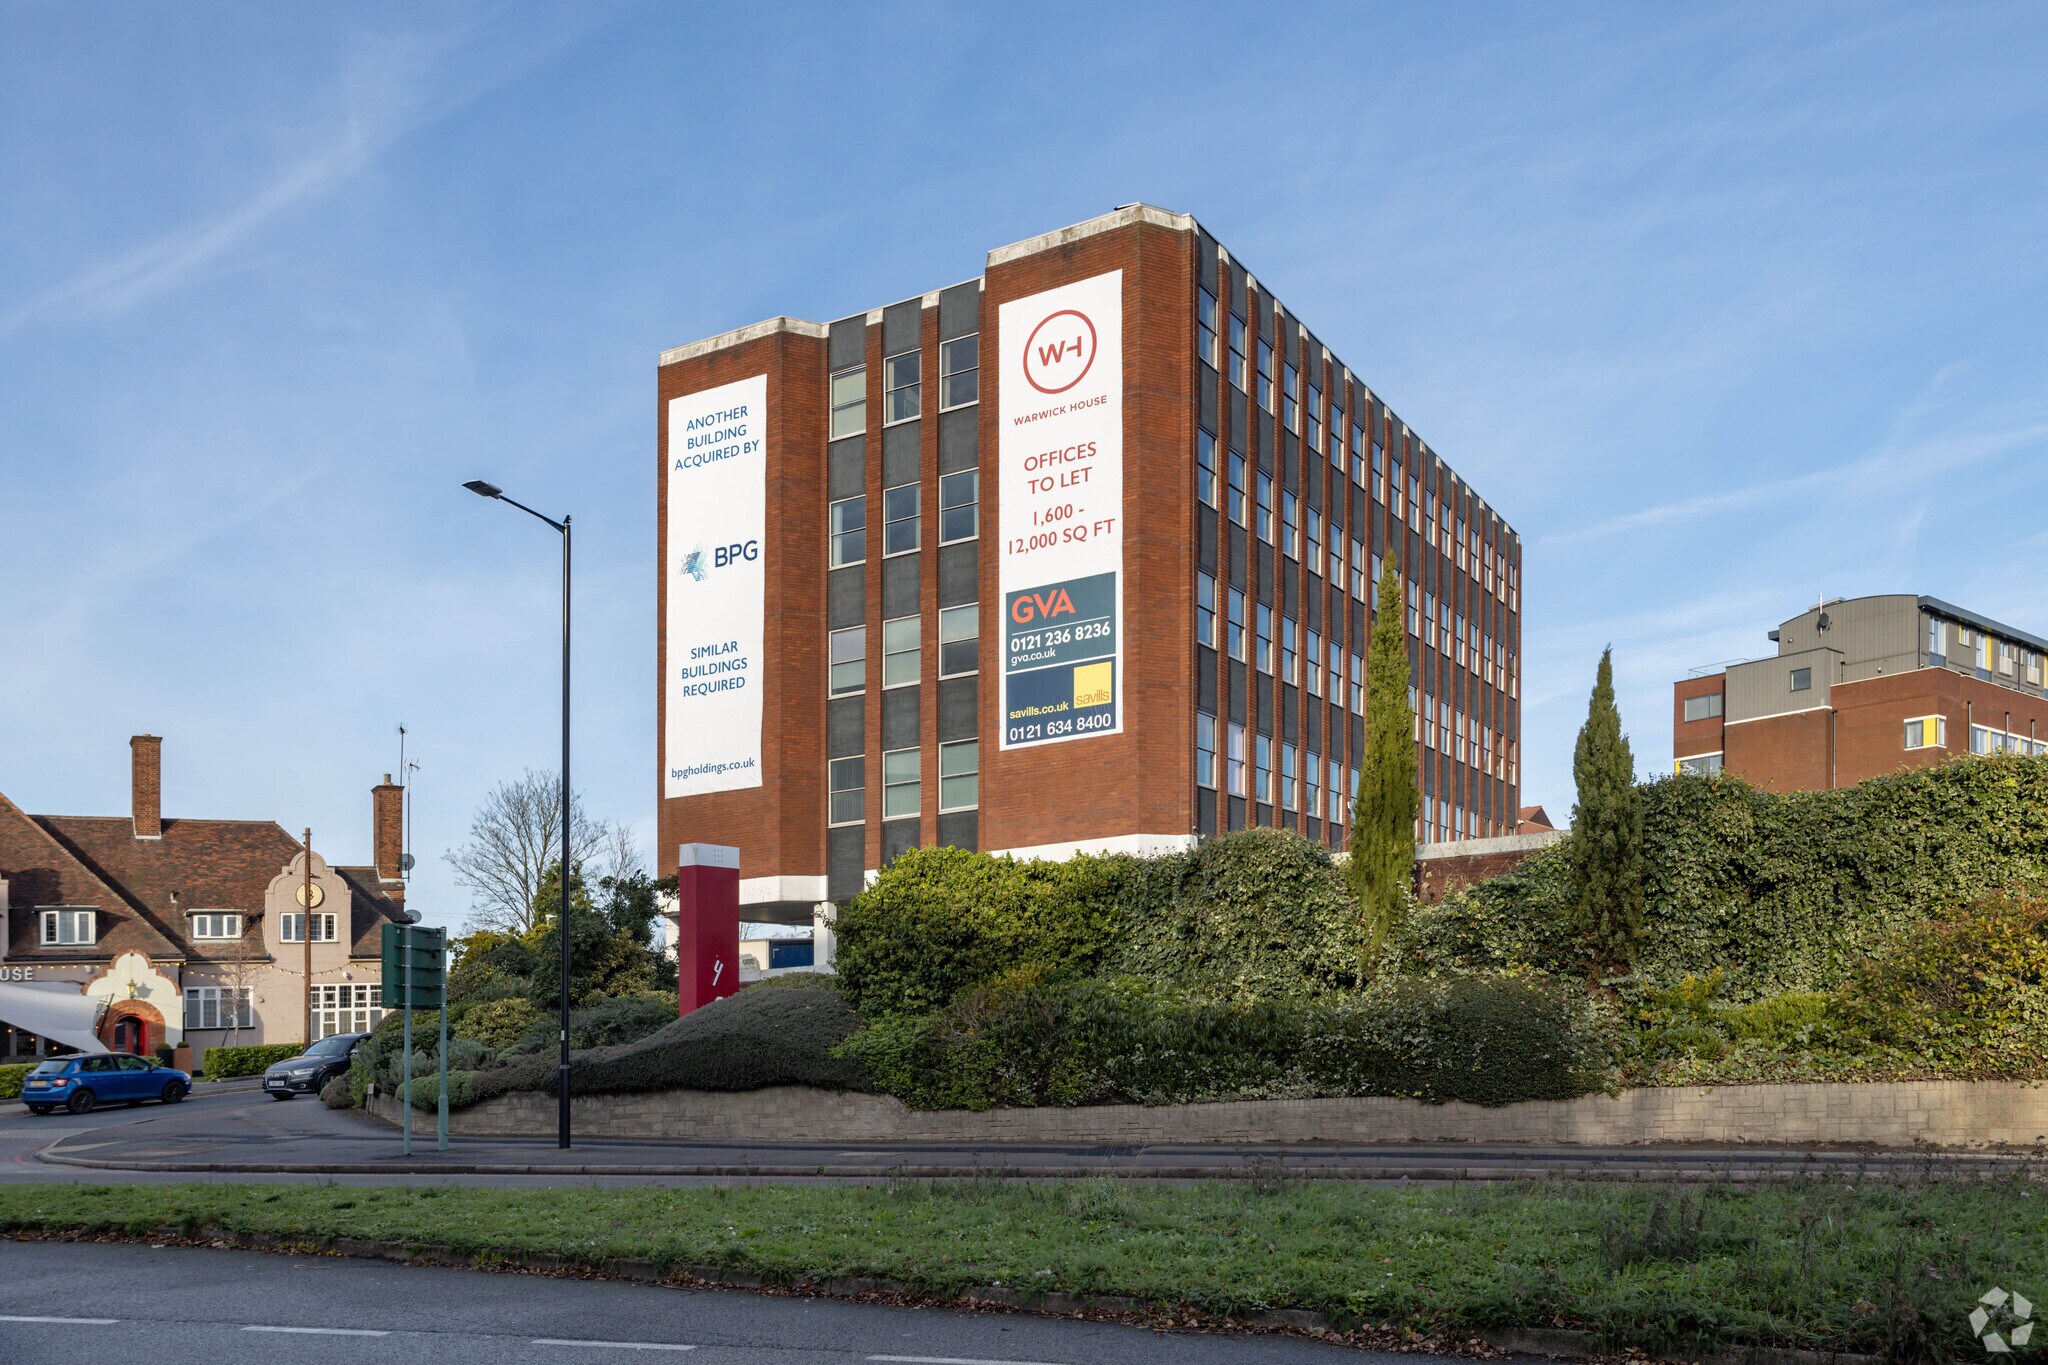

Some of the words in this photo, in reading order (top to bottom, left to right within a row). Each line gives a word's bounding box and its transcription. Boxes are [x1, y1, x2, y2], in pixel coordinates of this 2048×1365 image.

[686, 405, 748, 432] ANOTHER
[1013, 405, 1066, 426] WARWICK
[1069, 395, 1107, 412] HOUSE
[687, 424, 747, 450] BUILDING
[674, 445, 740, 471] ACQUIRED
[743, 439, 760, 454] BY
[1024, 441, 1097, 472] OFFICES
[1027, 476, 1055, 495] TO
[1061, 466, 1093, 488] LET
[1033, 503, 1073, 527] 1,600
[1009, 531, 1057, 555] 12,000
[1062, 525, 1088, 543] SQ
[1093, 518, 1115, 537] FT
[714, 539, 758, 568] BPG
[1011, 588, 1076, 624] GVA
[690, 640, 738, 660] SIMILAR
[1010, 634, 1041, 652] 0121
[1045, 628, 1071, 647] 236
[1075, 621, 1111, 641] 8236
[681, 657, 748, 680] BUILDINGS
[1011, 647, 1056, 667] gva.co.uk
[683, 676, 746, 697] REQUIRED
[1075, 689, 1110, 706] savills
[1009, 701, 1069, 719] savills.co.uk
[1009, 724, 1041, 741] 0121
[1046, 719, 1072, 736] 634
[1076, 713, 1112, 731] 8400
[671, 757, 755, 780] bpgholdings.co.uk
